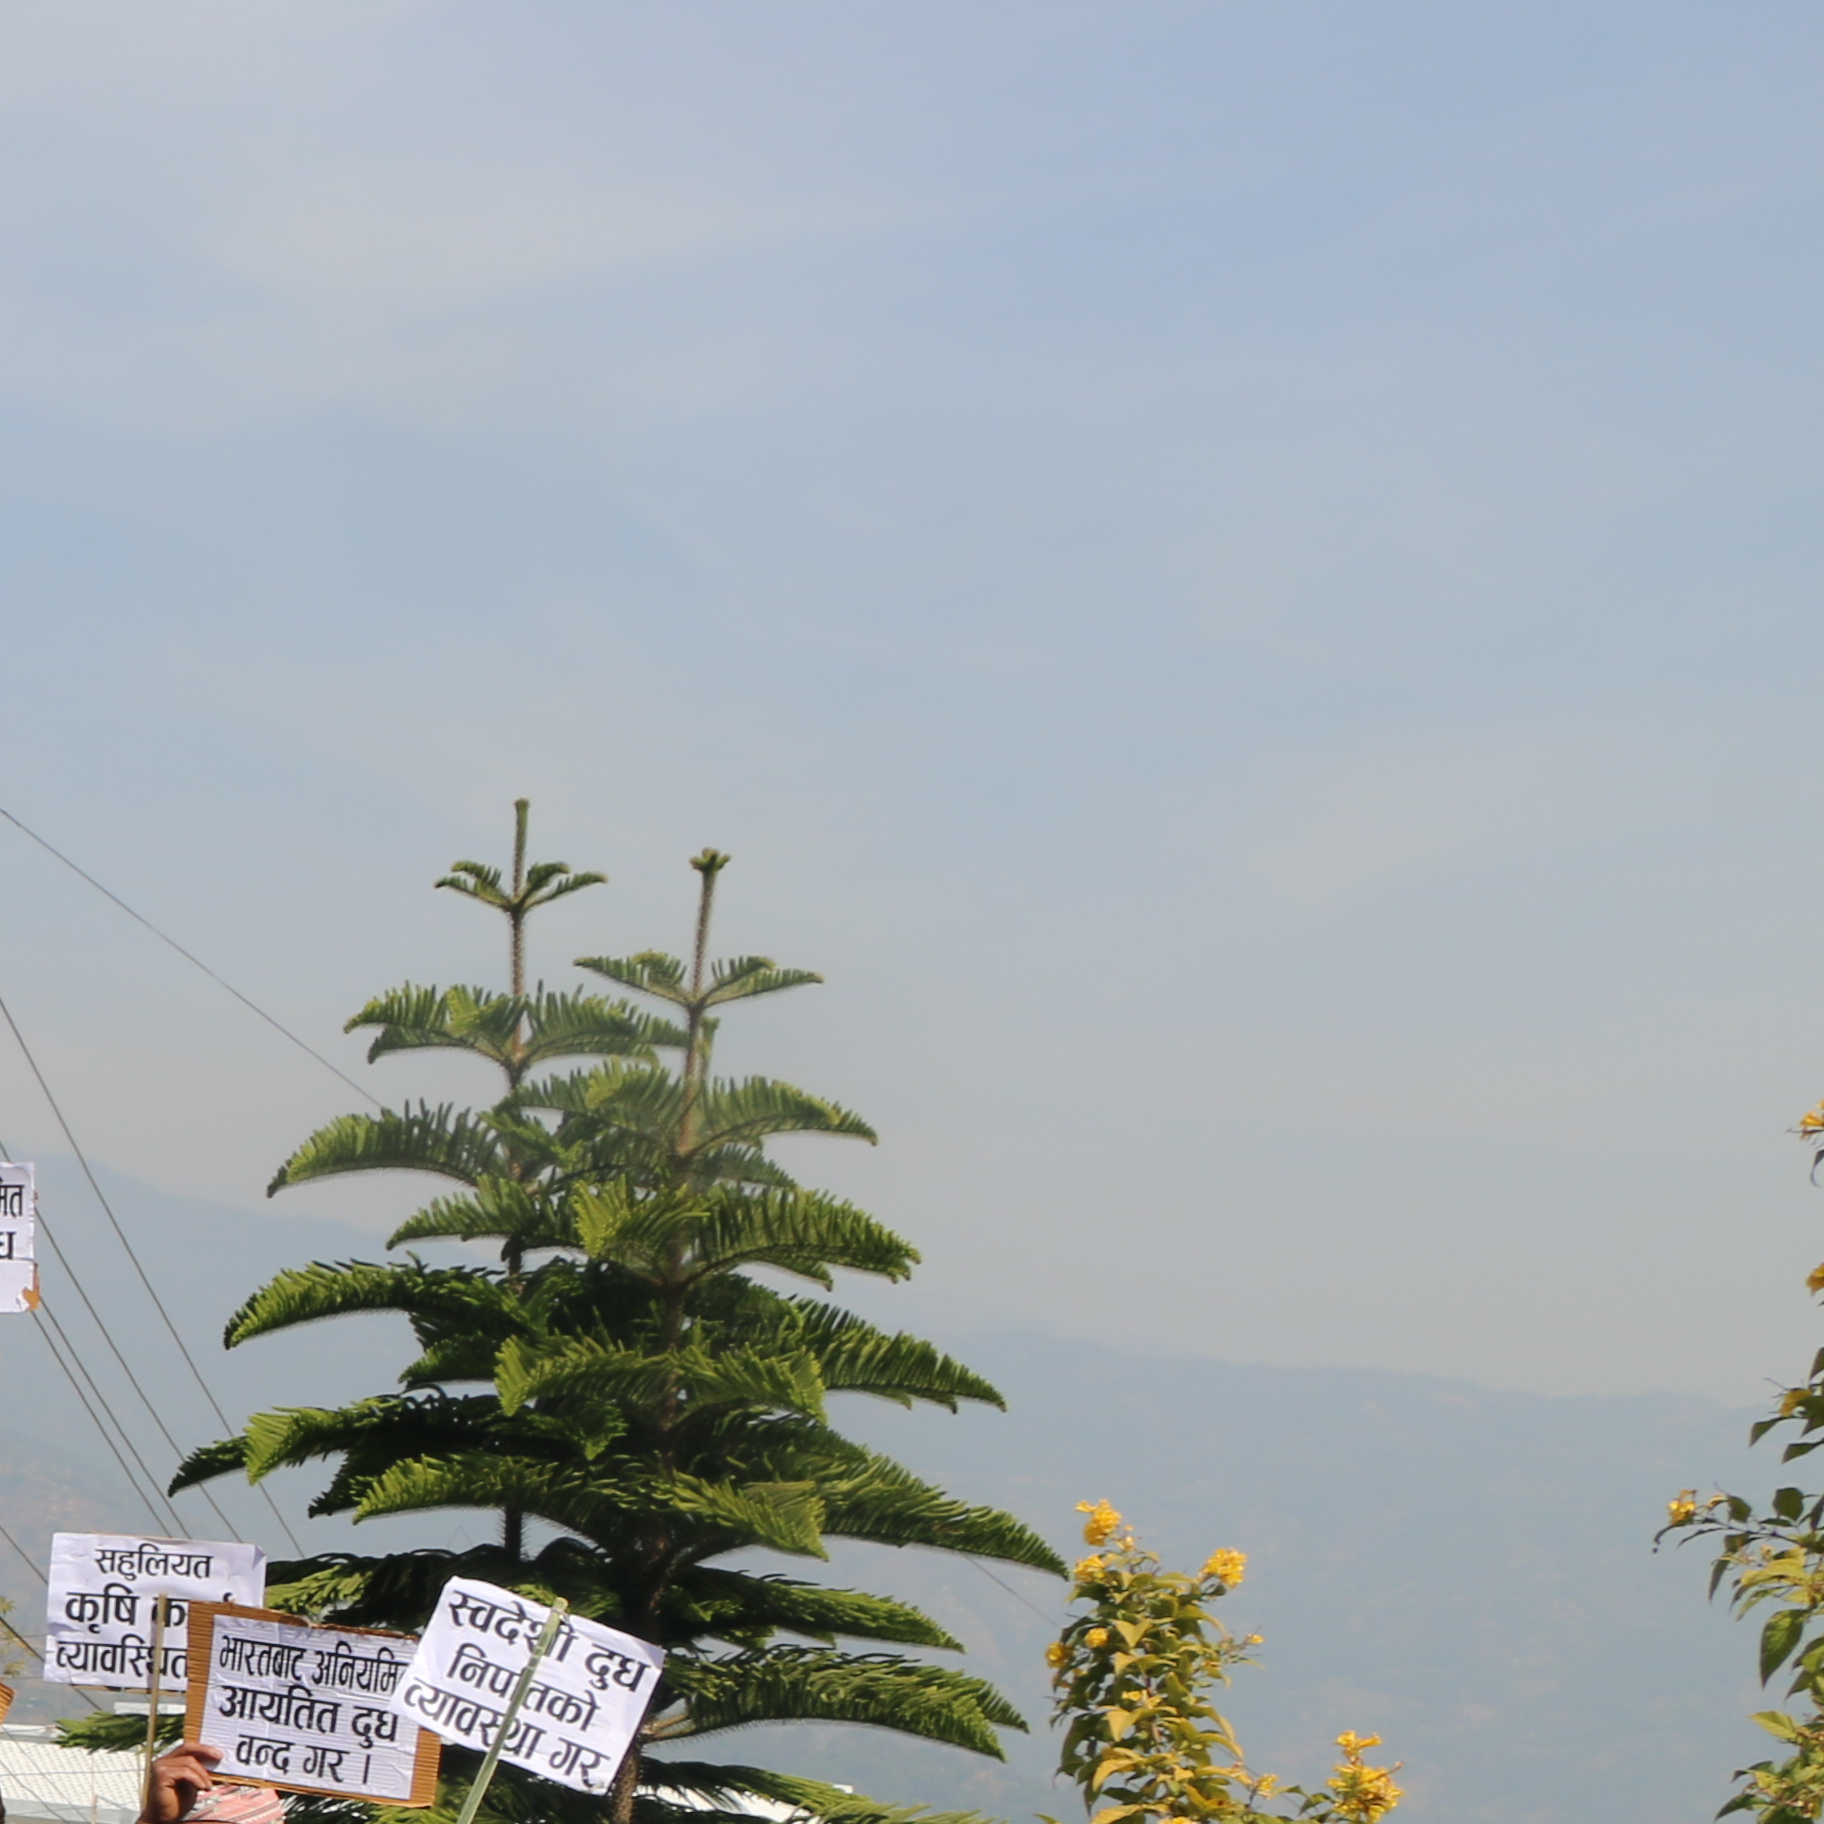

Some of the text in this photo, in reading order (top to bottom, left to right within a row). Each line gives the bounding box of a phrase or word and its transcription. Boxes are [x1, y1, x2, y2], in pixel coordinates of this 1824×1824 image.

[95, 1543, 212, 1581] सहुलियत
[65, 1582, 139, 1634] कृषि
[219, 1634, 305, 1683] भारतबाट
[583, 1645, 653, 1694] दुध
[351, 1710, 398, 1749] दुध
[236, 1734, 351, 1783] वन्द गर
[549, 1739, 610, 1790] गर
